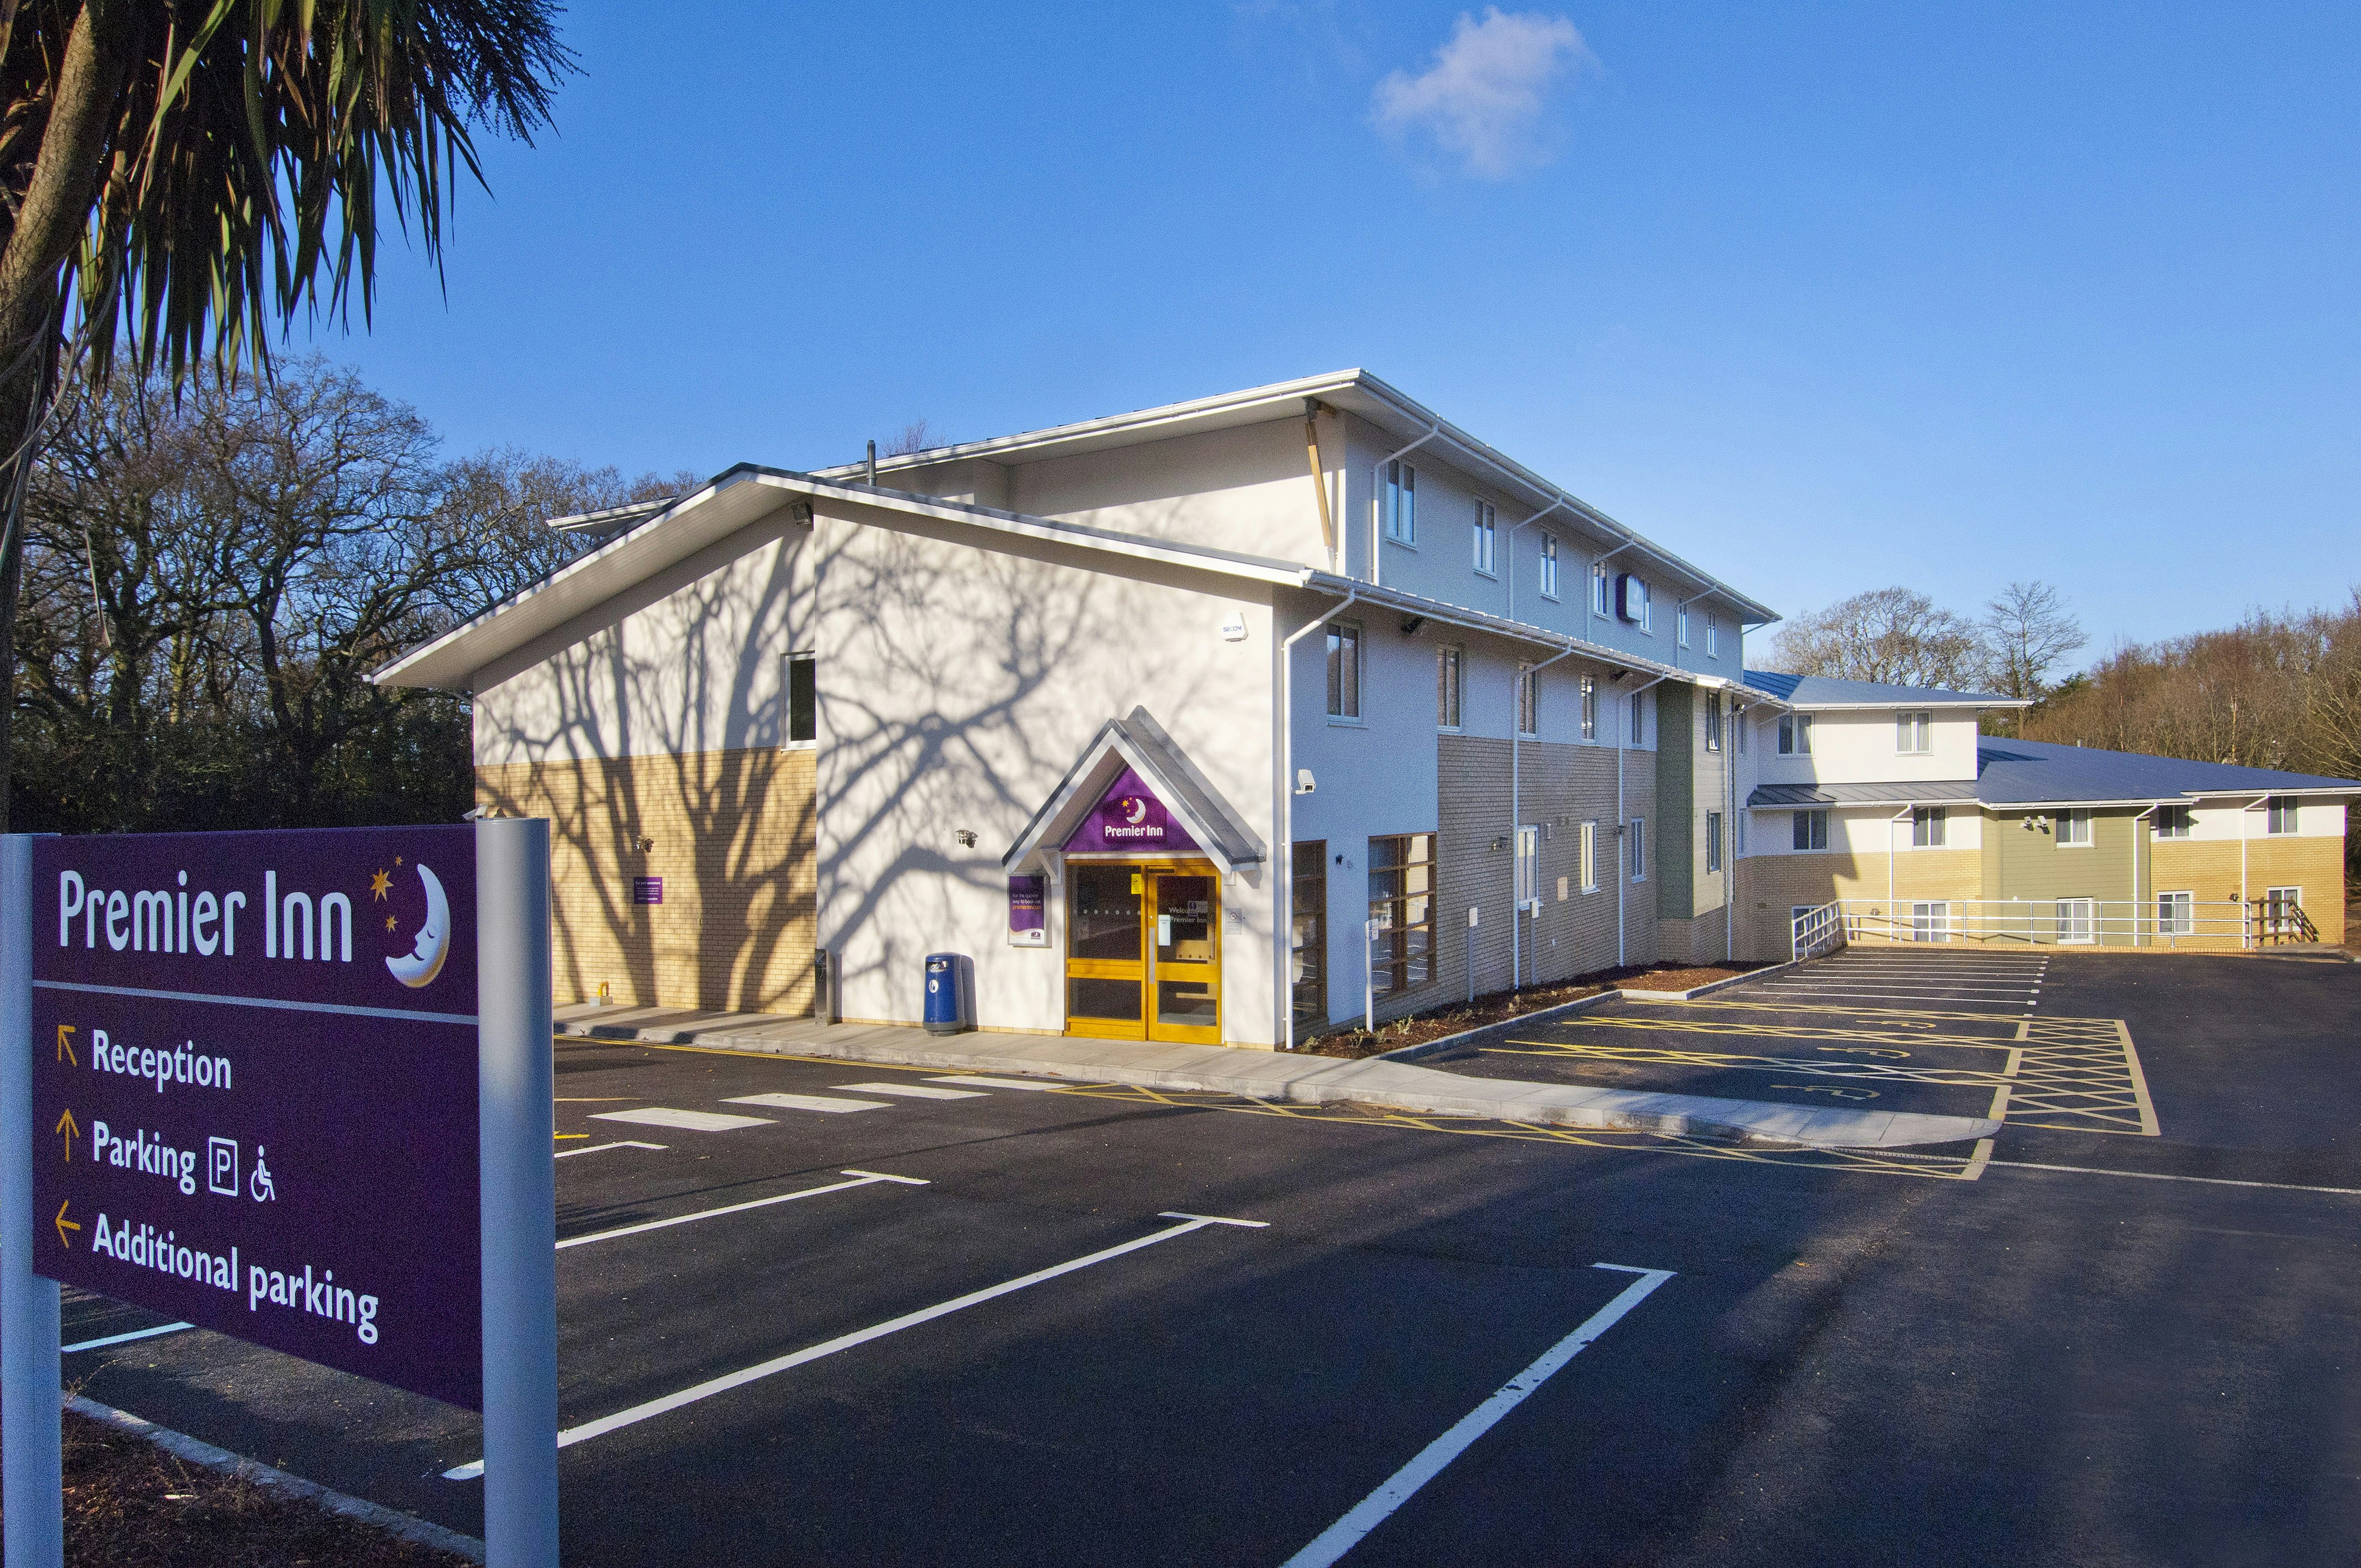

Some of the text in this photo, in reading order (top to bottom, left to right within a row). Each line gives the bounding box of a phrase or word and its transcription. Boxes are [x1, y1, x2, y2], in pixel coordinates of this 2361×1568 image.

[1105, 825, 1163, 837] Premier Inn
[60, 870, 352, 962] Premier Inn
[93, 1029, 231, 1093] Reception
[94, 1120, 231, 1195] Parking P
[93, 1213, 379, 1344] Additional parking
